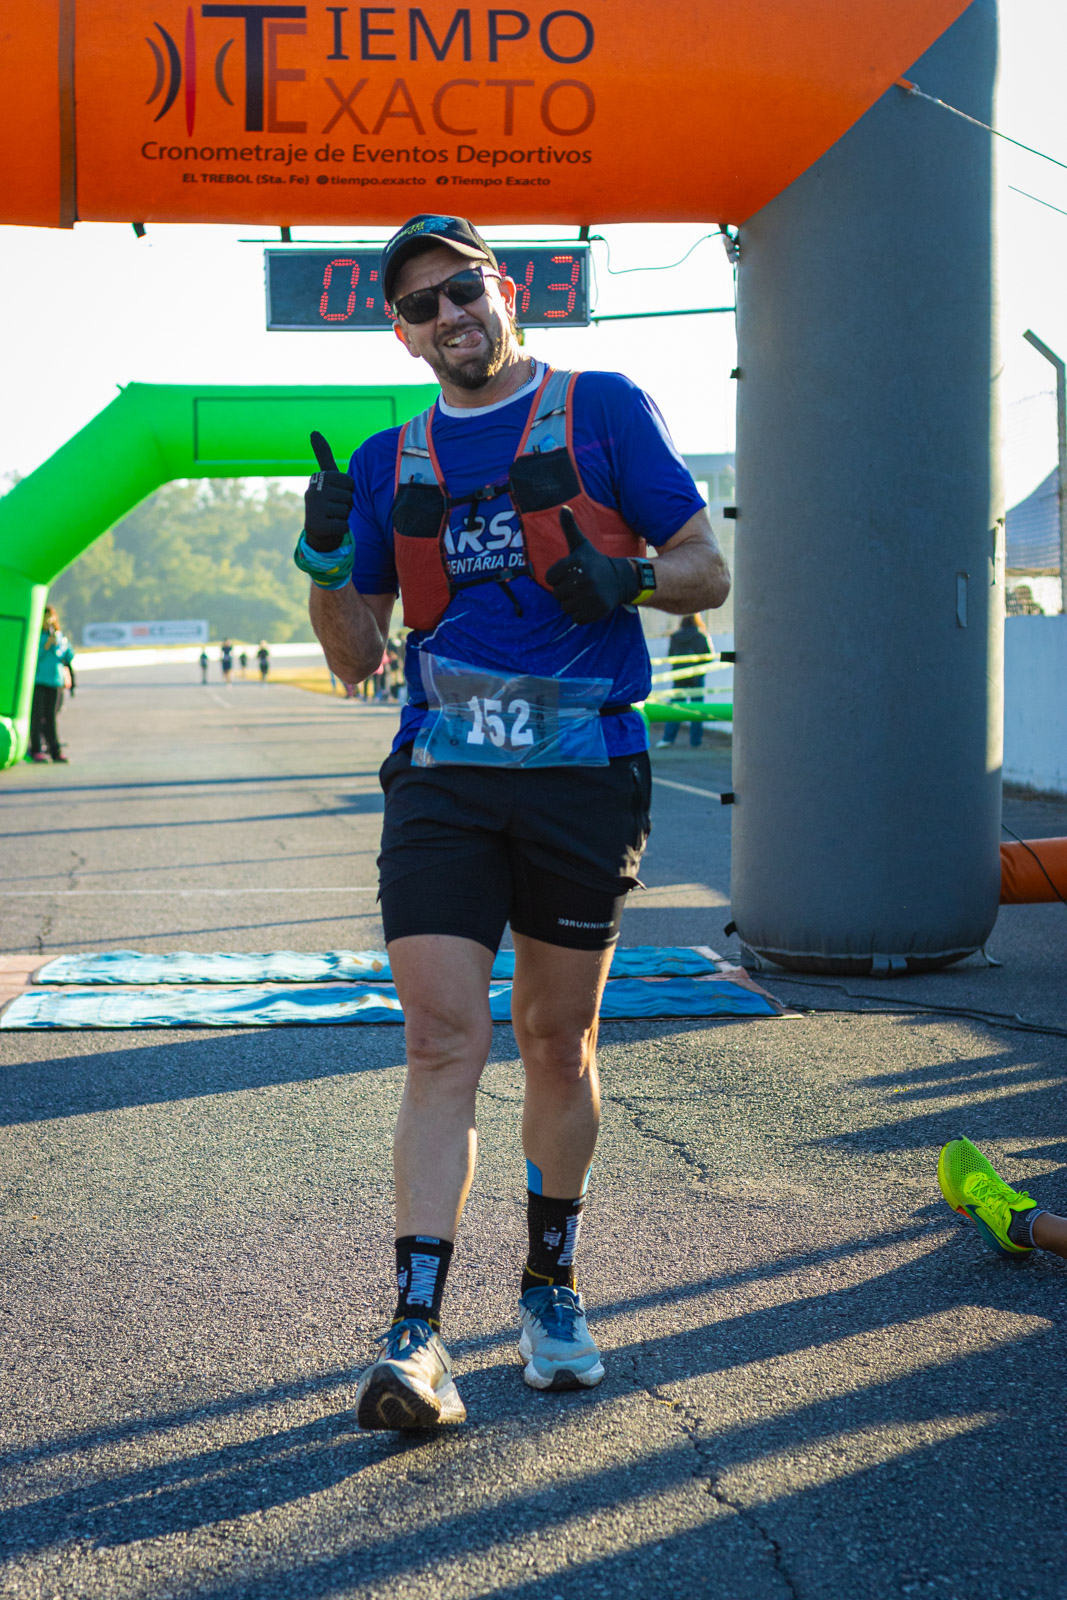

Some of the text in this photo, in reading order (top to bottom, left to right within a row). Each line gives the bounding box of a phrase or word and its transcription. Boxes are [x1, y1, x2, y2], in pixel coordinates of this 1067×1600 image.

[141, 141, 593, 167] Cronometraje de Eventos Deportivos
[182, 173, 551, 187] EL TREBOL (Sta. Fe) tiempo.exacto Tiempo Exacto
[466, 696, 534, 747] 152
[407, 1253, 440, 1308] RUNNING
